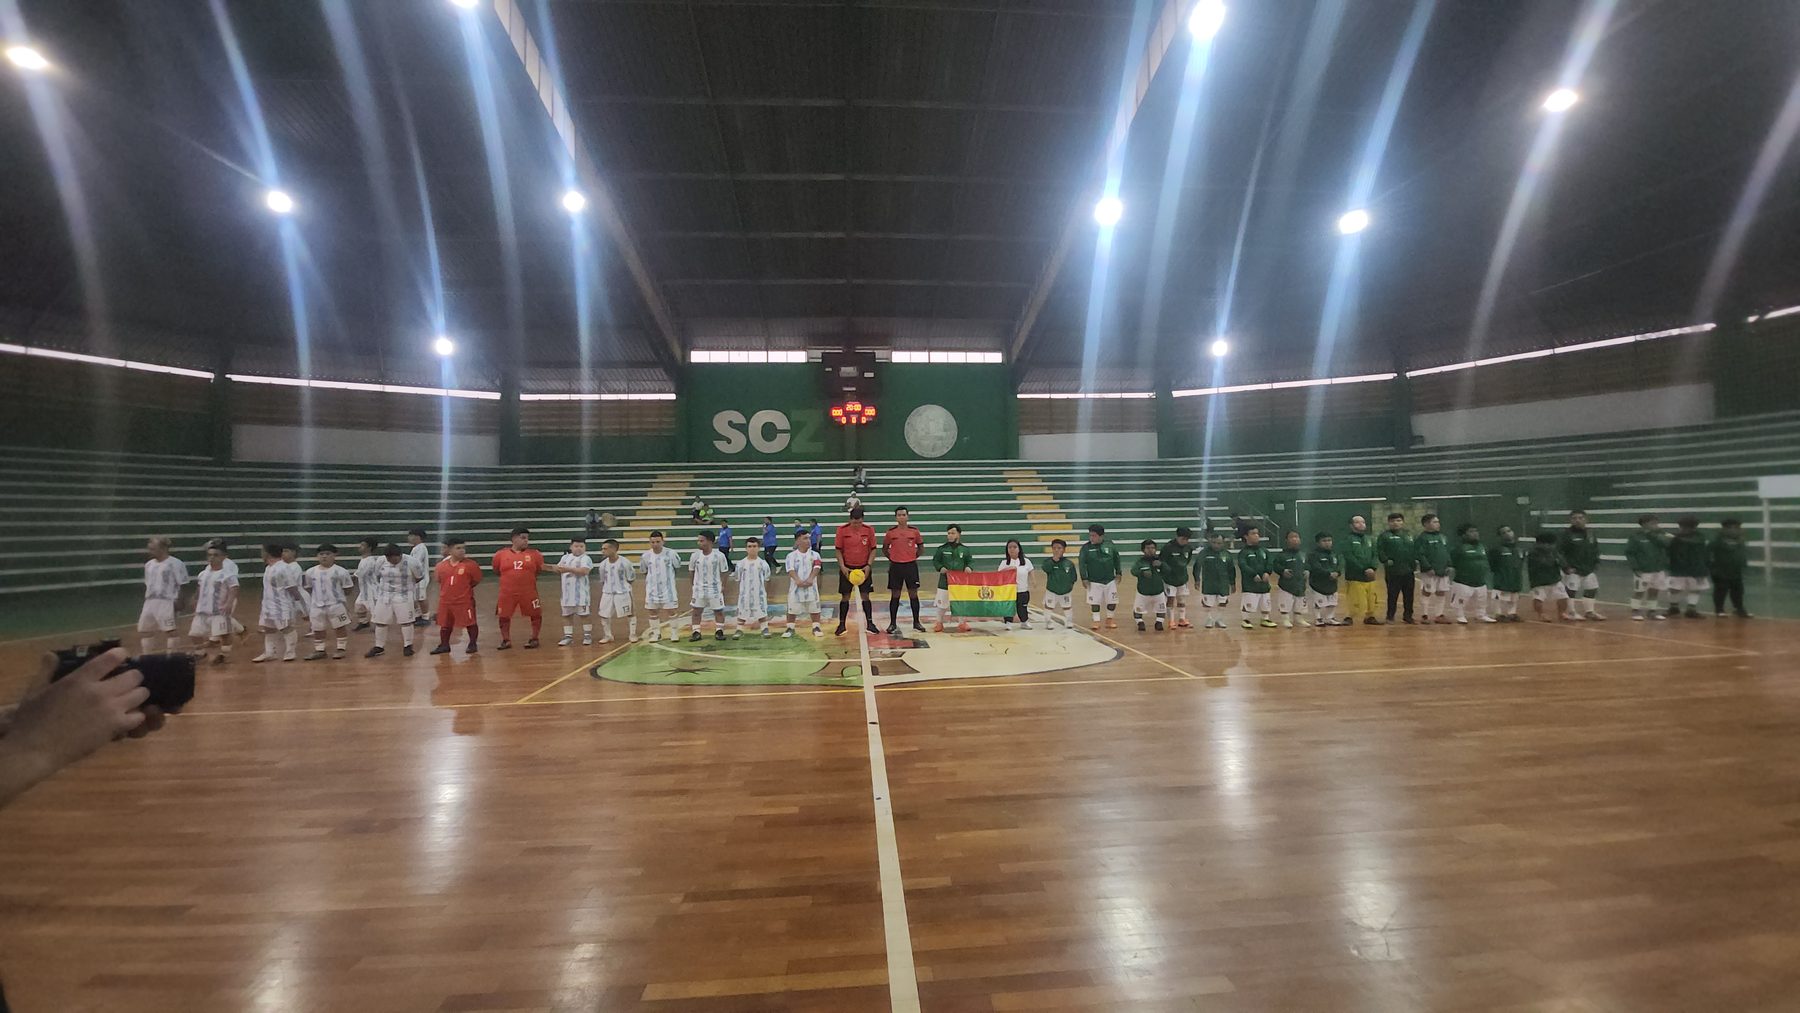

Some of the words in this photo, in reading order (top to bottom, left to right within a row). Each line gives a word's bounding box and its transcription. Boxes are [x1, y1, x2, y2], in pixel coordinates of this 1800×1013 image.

[712, 409, 824, 454] SCZ
[513, 560, 523, 570] 12
[450, 575, 454, 586] 1
[531, 598, 541, 609] 12
[467, 608, 472, 619] 1
